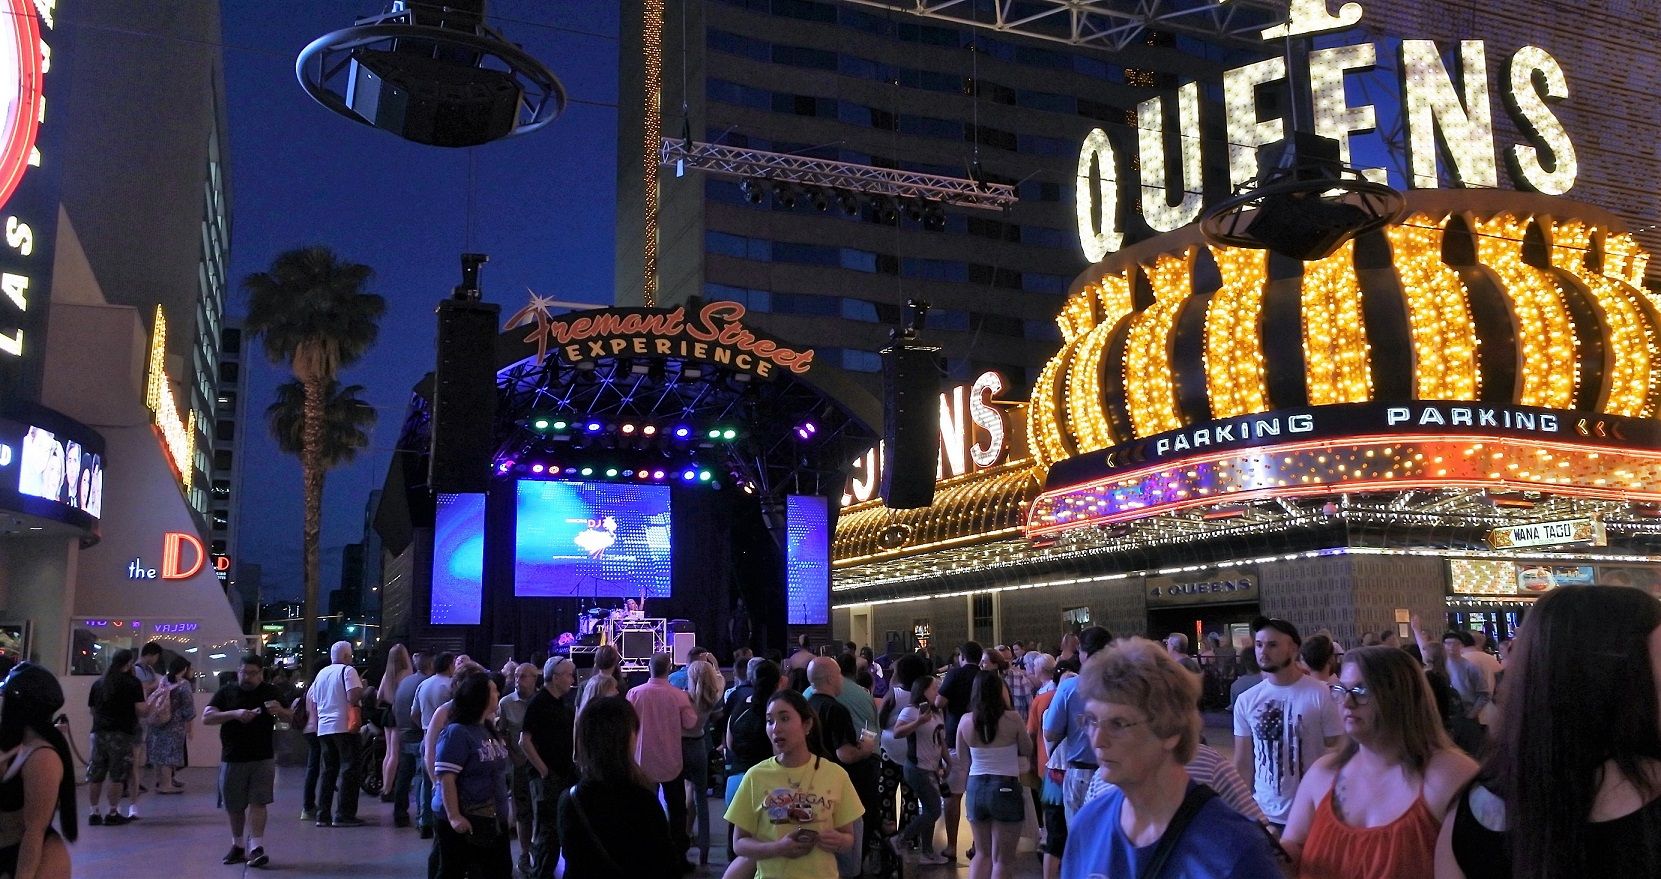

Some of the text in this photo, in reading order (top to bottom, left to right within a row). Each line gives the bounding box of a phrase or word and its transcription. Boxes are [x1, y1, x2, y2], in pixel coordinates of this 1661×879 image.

[1076, 39, 1578, 264] QUEENS
[0, 215, 33, 357] LAS
[504, 300, 815, 374] Fremont Street
[566, 337, 772, 378] EXPERIENCE
[1156, 414, 1314, 456] PARKING
[1387, 407, 1558, 432] PARKING
[1513, 523, 1571, 541] WANA TACO
[128, 532, 204, 580] the D
[1151, 578, 1252, 598] 4 QUEENS
[788, 792, 833, 811] VEGAS
